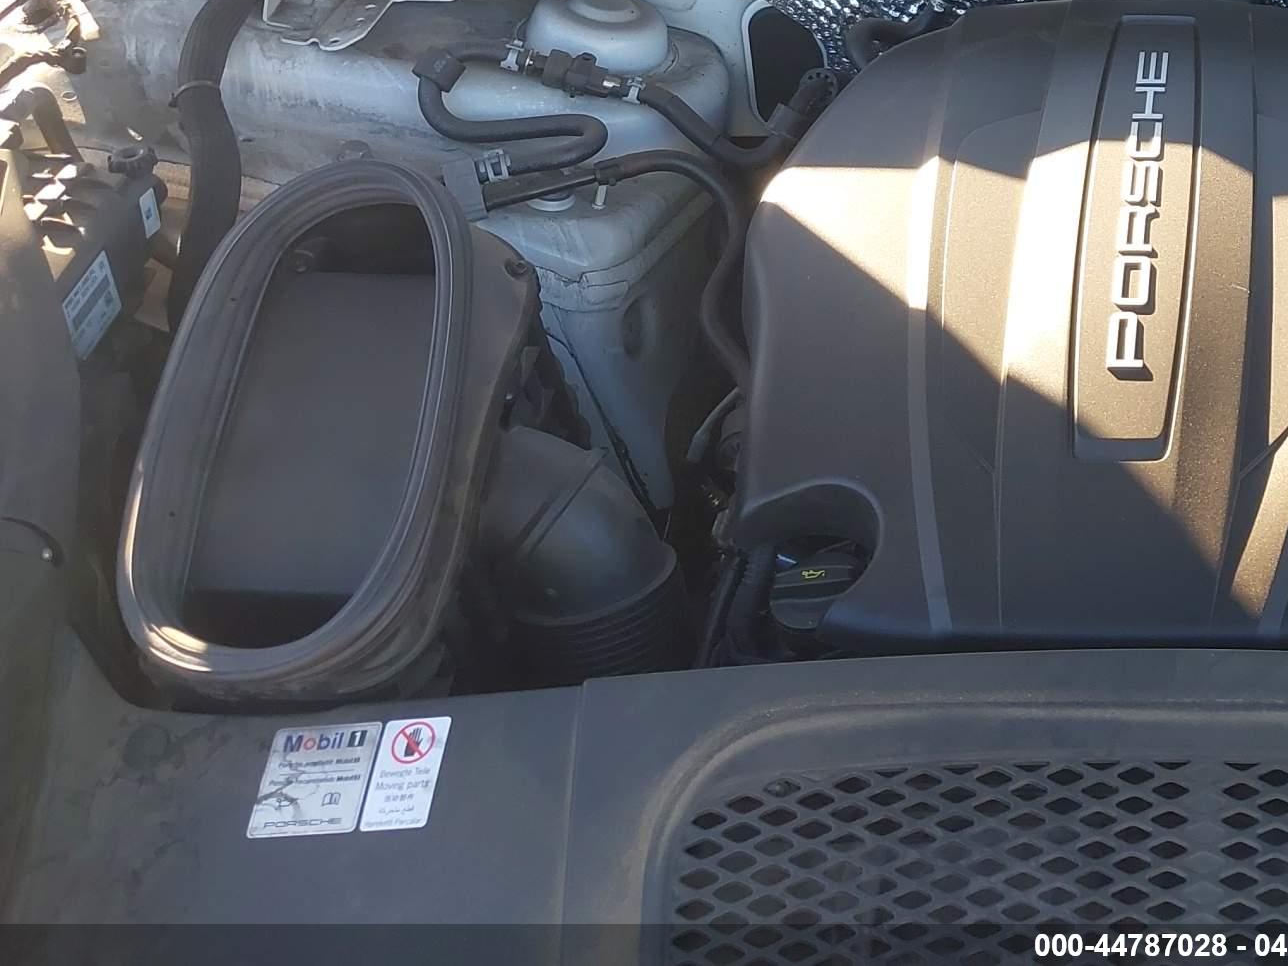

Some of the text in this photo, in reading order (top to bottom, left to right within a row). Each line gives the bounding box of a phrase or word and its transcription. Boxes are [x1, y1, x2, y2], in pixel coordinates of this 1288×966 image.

[1106, 51, 1169, 371] PORSCHE
[283, 732, 344, 752] Mobil
[263, 817, 342, 828] PORSCHE
